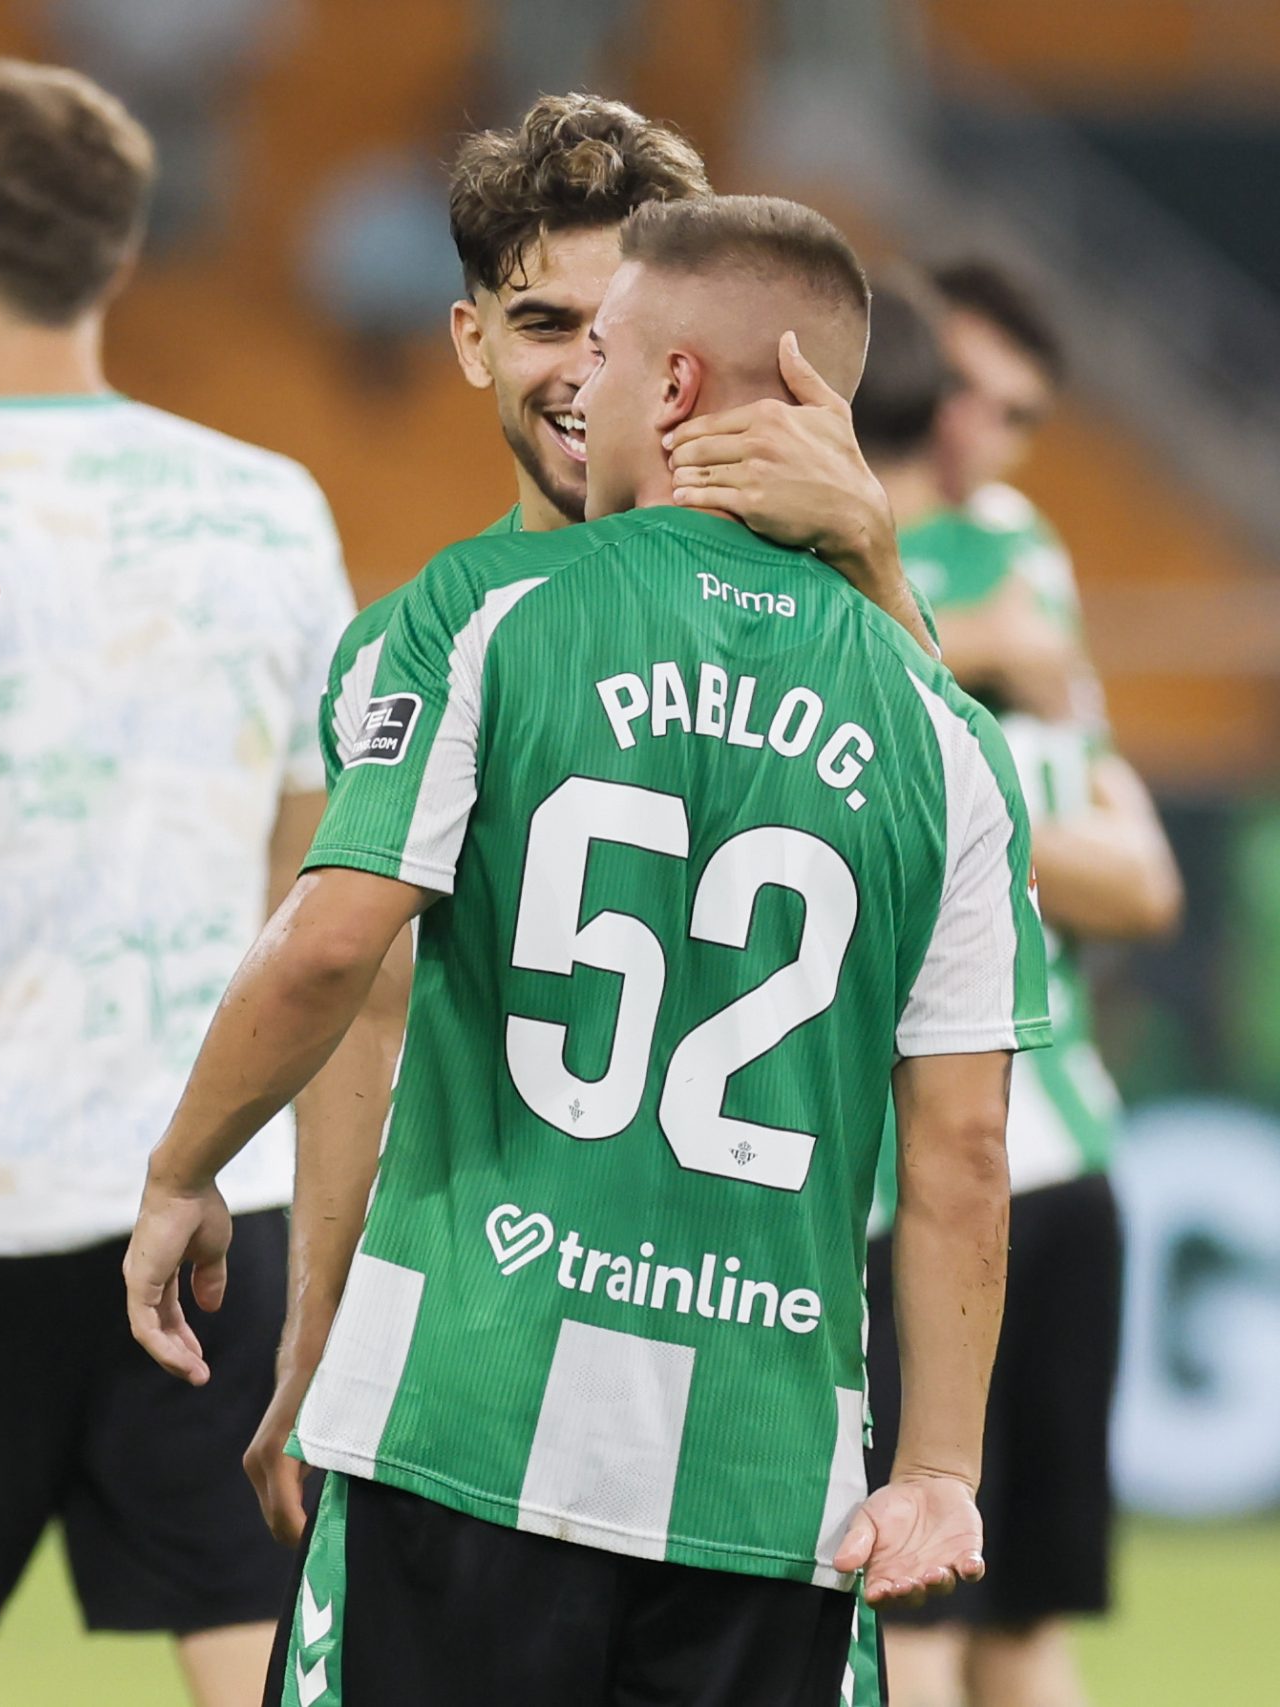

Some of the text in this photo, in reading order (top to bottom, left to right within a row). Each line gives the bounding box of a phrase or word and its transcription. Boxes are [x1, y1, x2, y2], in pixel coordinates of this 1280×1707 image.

[696, 571, 797, 618] prima
[594, 660, 876, 813] PABLO G.
[504, 774, 860, 1194] 52
[556, 1230, 822, 1335] trainline
